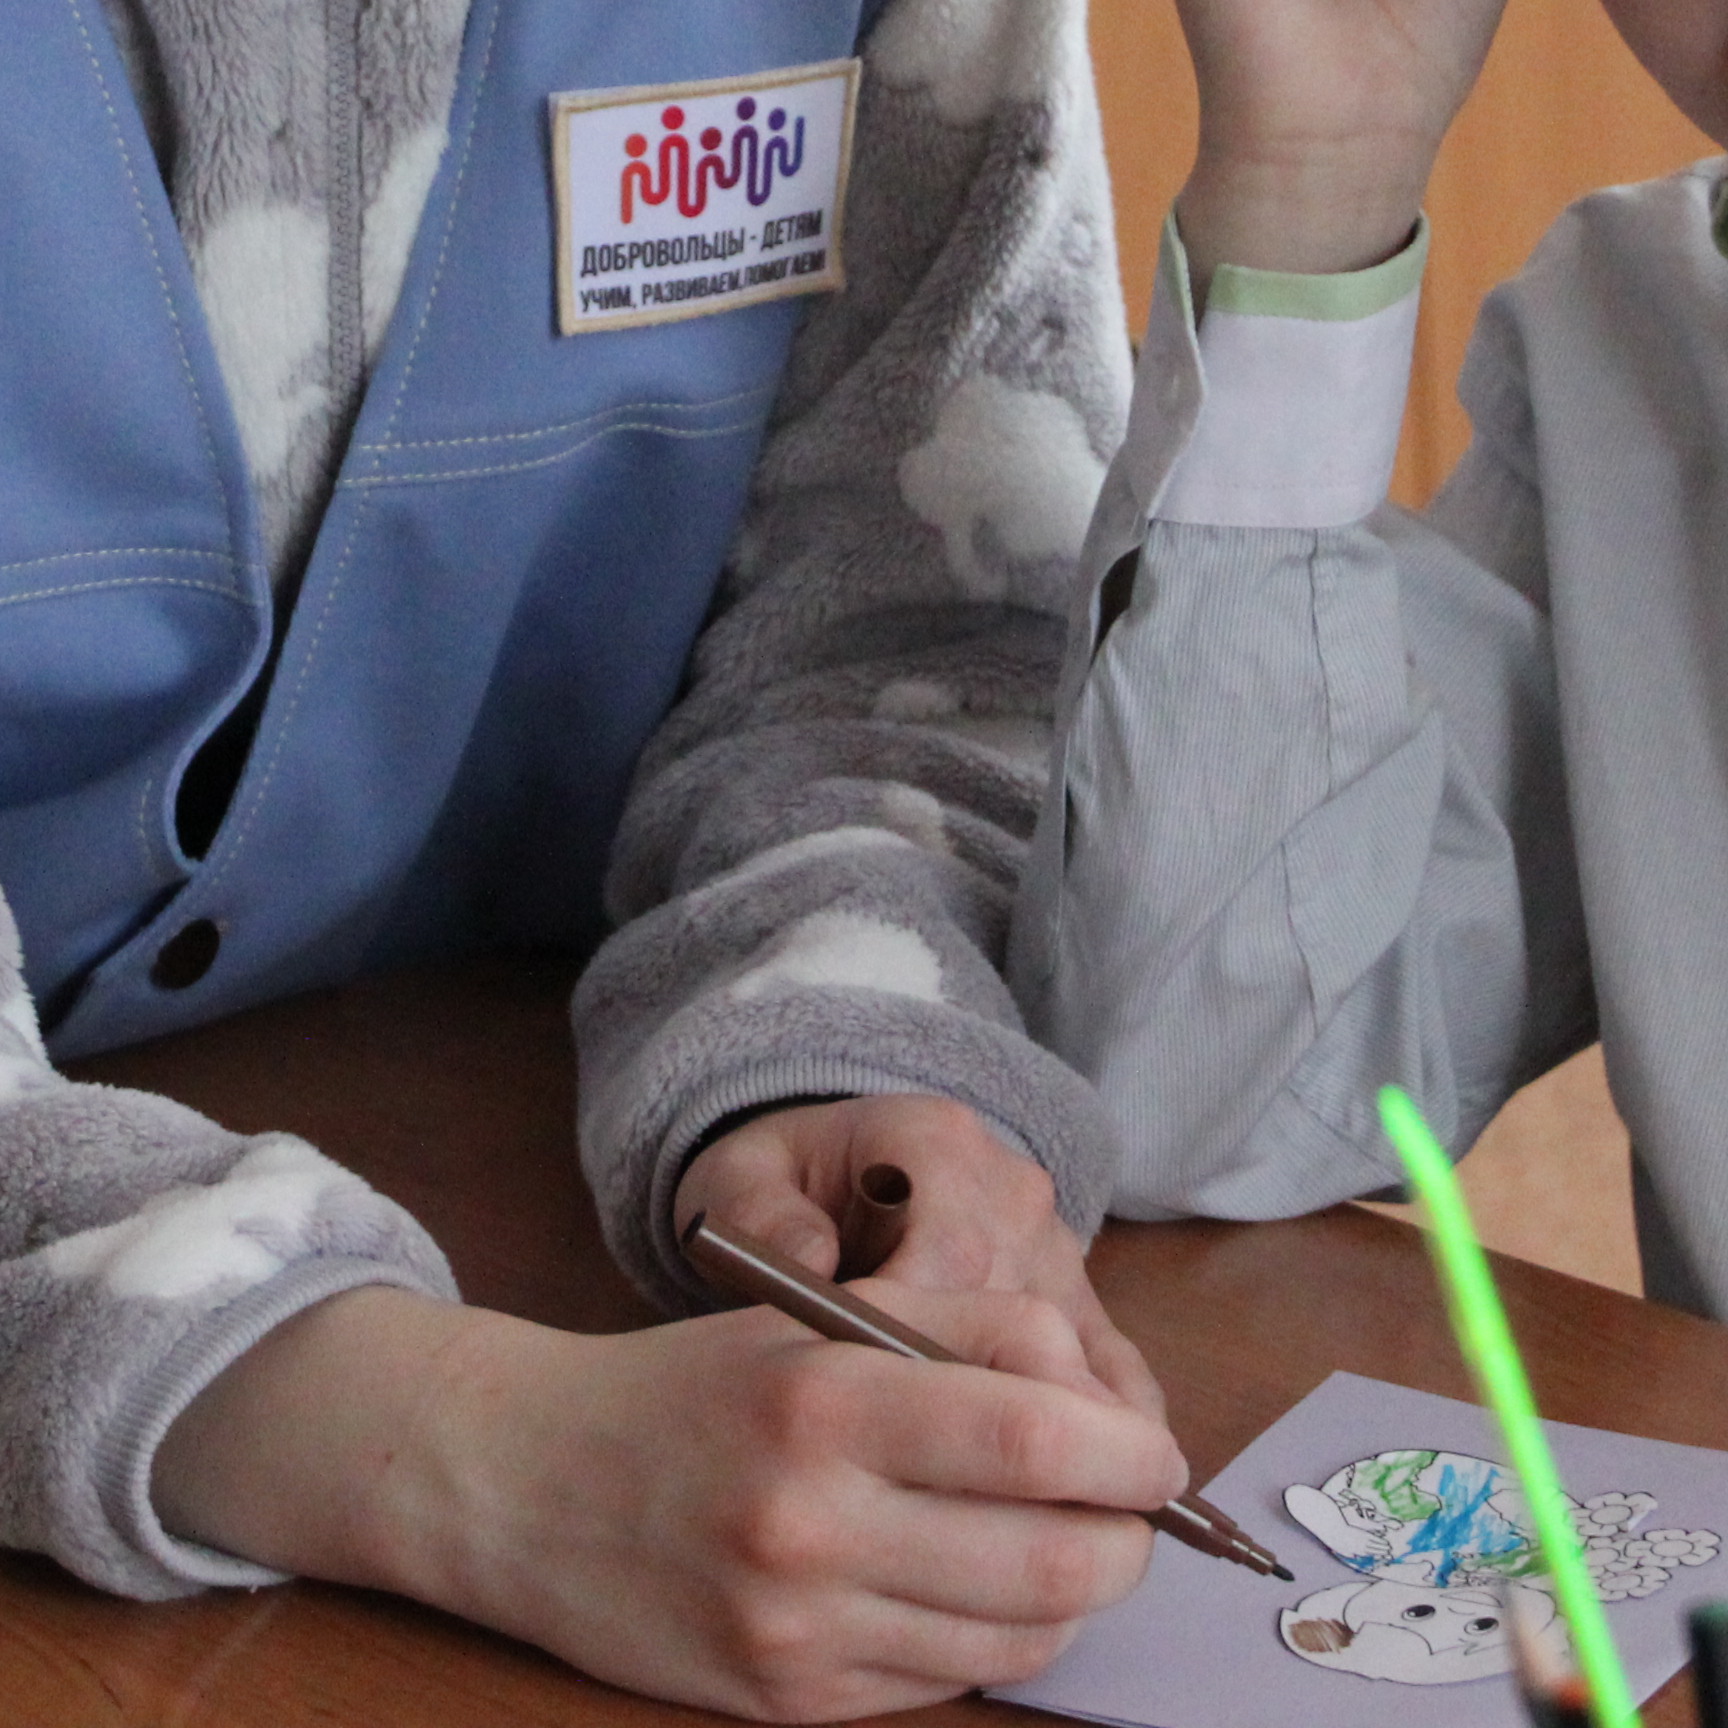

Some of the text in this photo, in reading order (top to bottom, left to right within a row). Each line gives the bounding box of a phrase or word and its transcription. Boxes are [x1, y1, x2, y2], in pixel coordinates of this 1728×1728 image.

[580, 226, 745, 278] ДОБРОВОЛЬЦЫ
[760, 209, 823, 252] ДЕТЯМ
[580, 285, 637, 313] УЧИМ,
